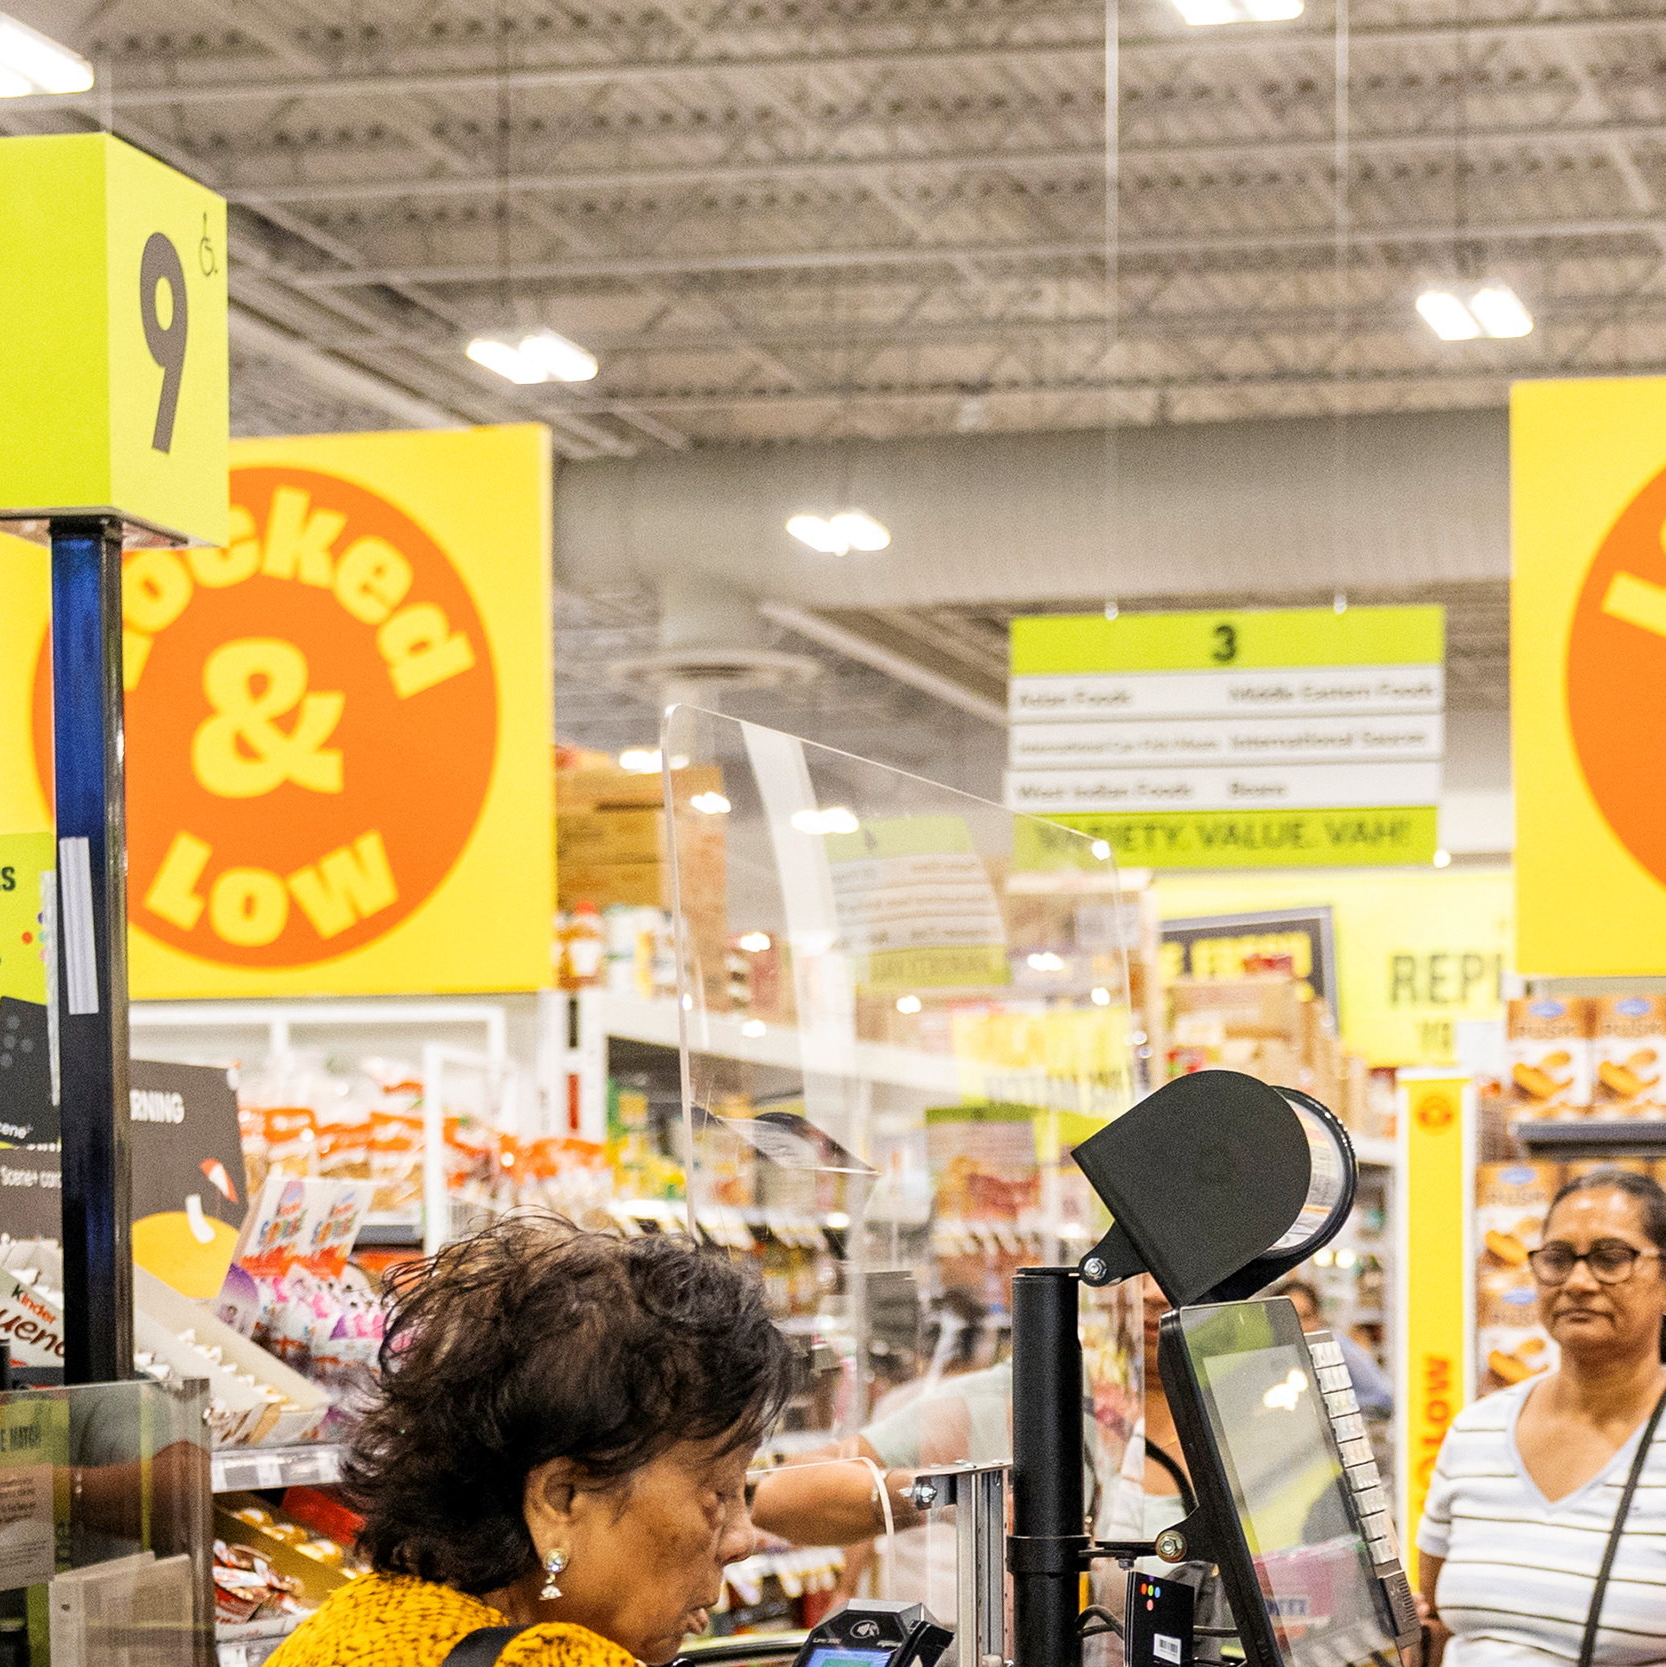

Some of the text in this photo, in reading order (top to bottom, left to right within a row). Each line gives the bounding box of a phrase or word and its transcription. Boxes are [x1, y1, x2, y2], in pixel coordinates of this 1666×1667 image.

[139, 231, 190, 456] 9
[121, 485, 476, 700] ocked
[1211, 623, 1238, 665] 3
[190, 637, 345, 799] &
